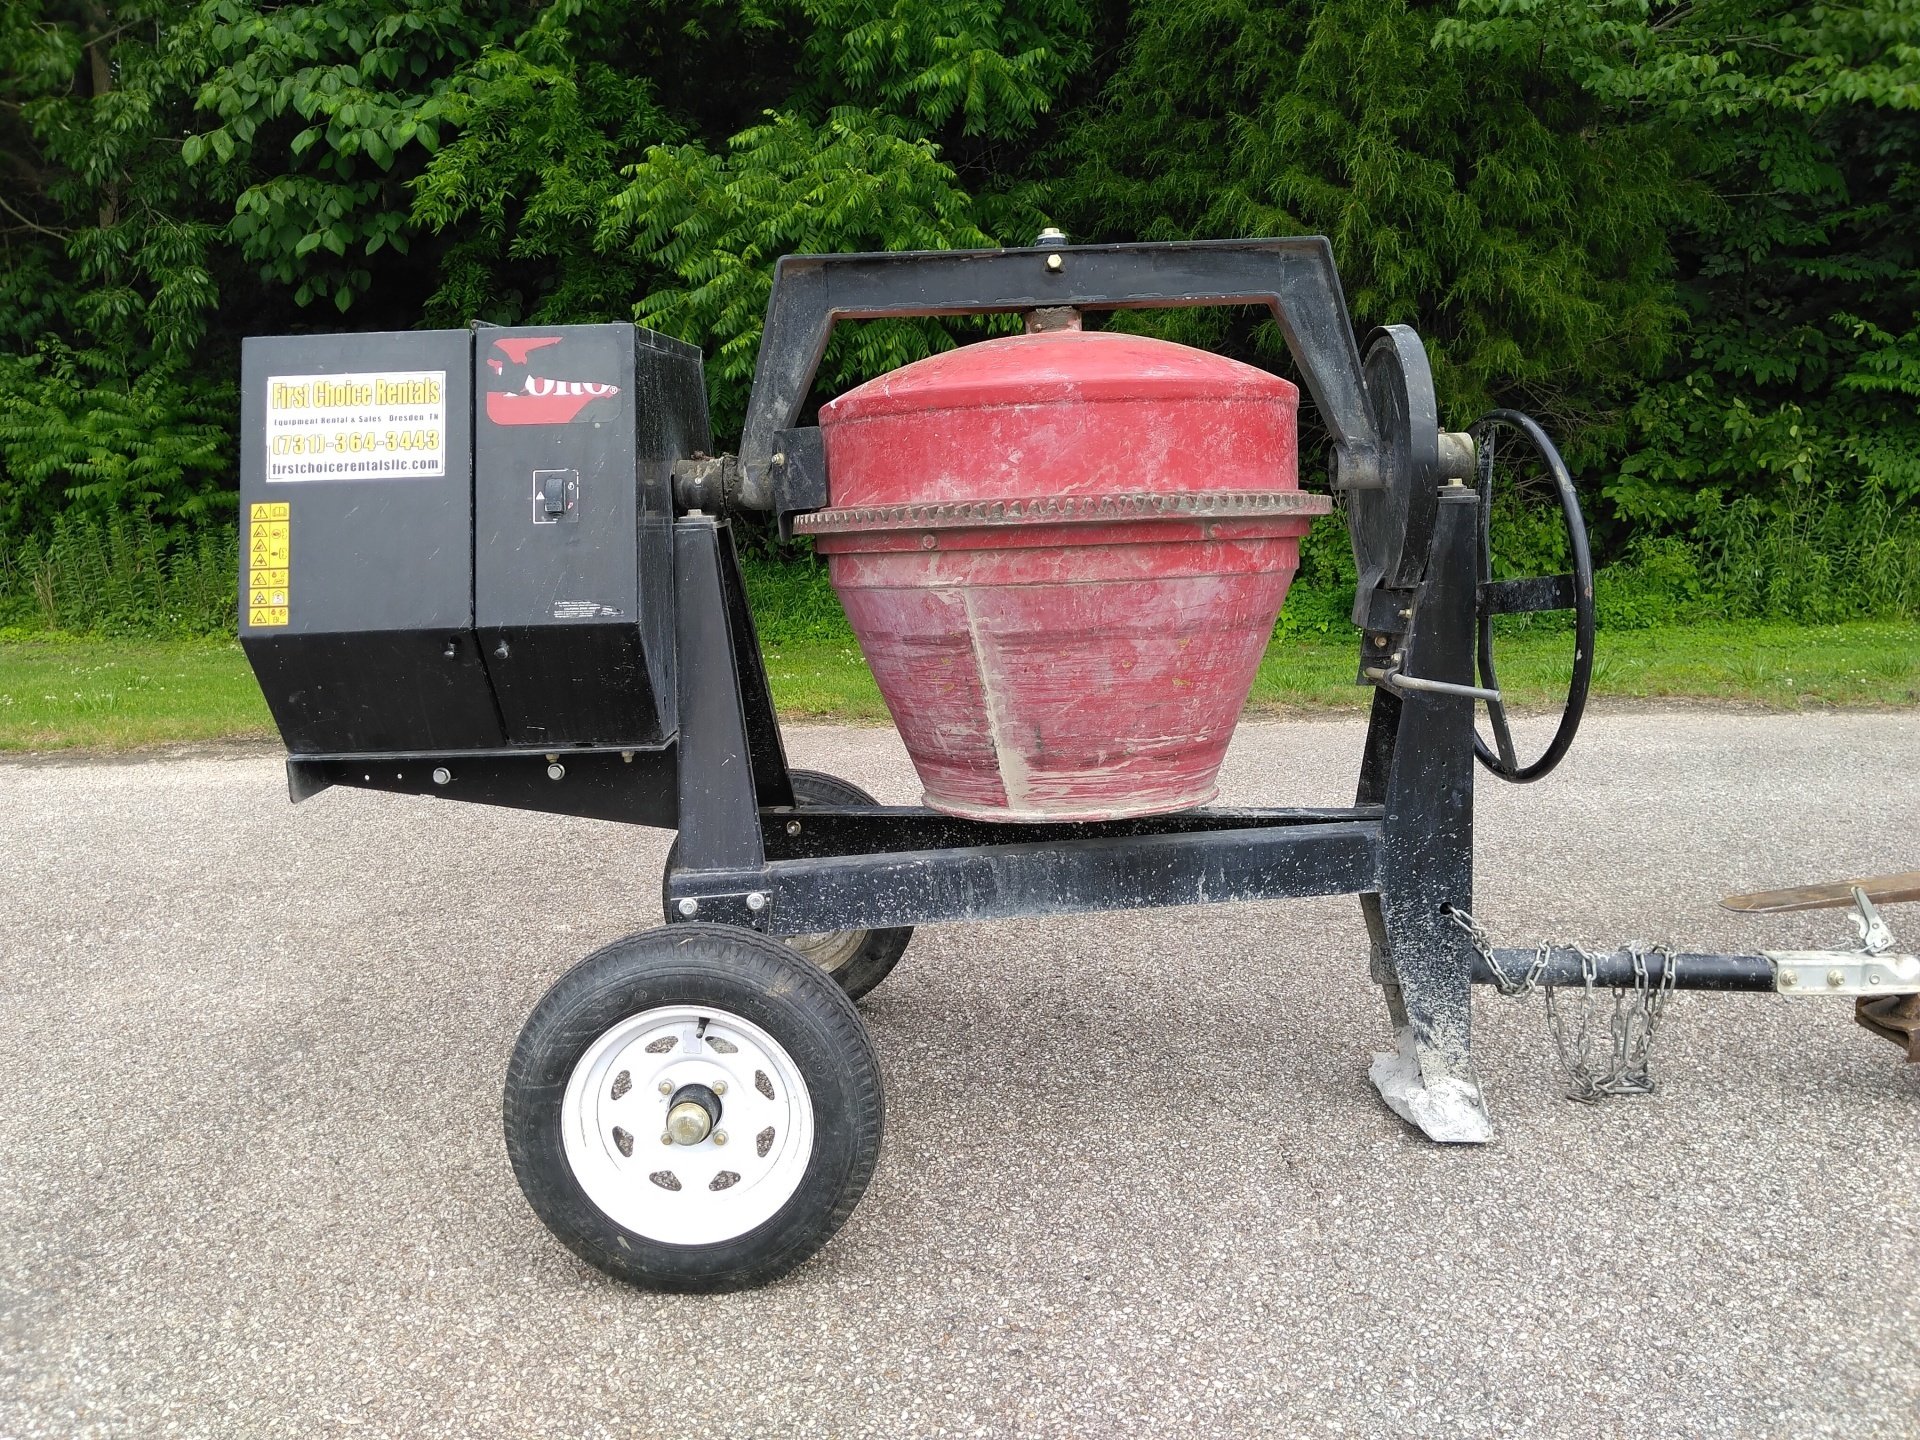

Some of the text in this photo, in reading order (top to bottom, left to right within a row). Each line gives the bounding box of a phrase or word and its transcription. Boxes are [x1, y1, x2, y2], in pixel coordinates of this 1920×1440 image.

[272, 377, 441, 409] First Choice Rentals
[274, 418, 318, 426] Equipment
[321, 416, 348, 425] Rental
[358, 415, 382, 423] Sales
[389, 413, 424, 422] Dresden
[272, 429, 440, 455] (731)-364-3443
[272, 459, 439, 475] firstchoicerentalsllc.com
